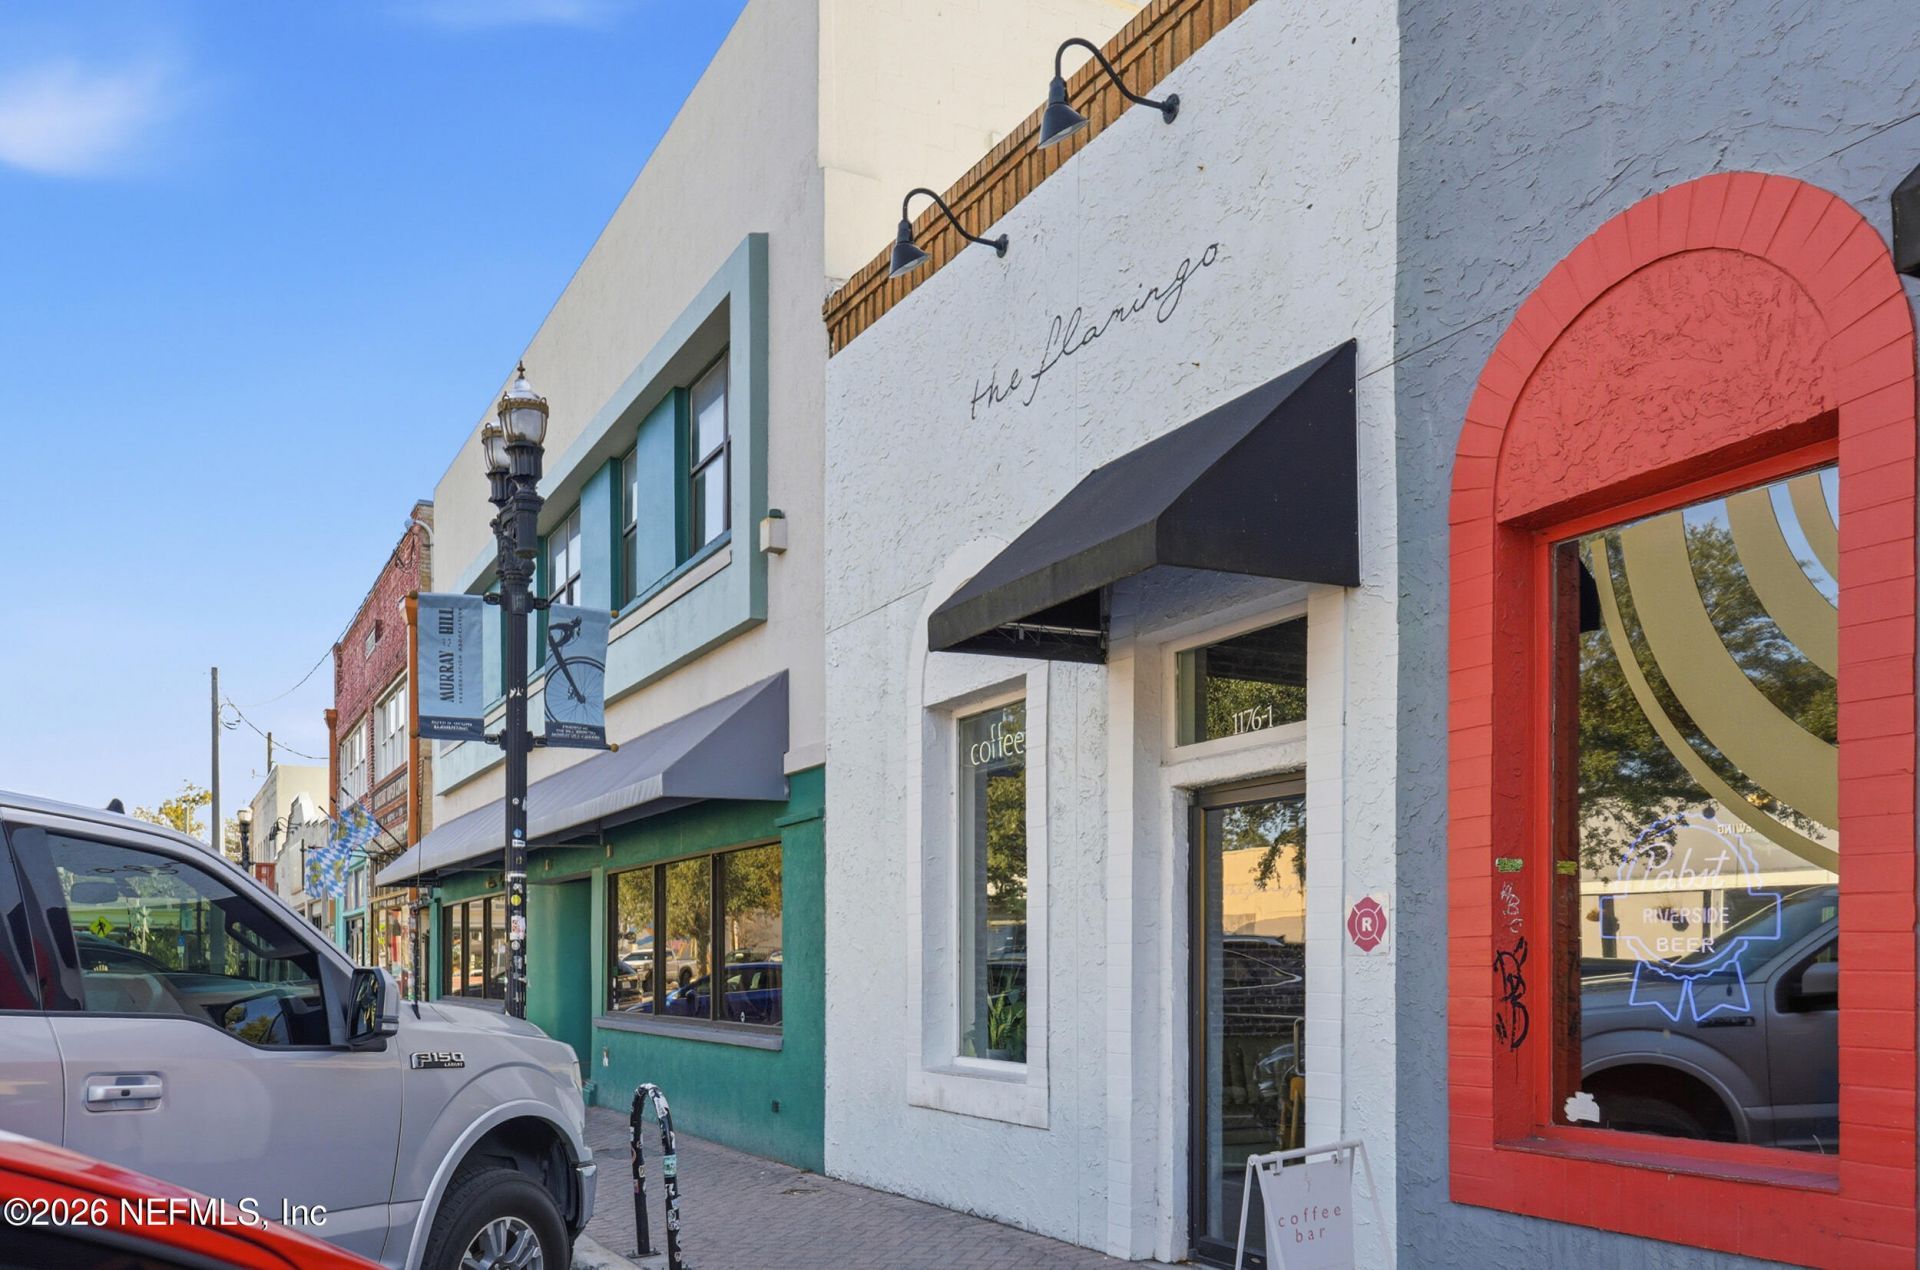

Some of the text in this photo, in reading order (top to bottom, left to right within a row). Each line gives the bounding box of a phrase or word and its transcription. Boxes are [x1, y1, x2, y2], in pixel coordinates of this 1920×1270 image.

[971, 243, 1219, 420] the flamingo
[438, 607, 454, 703] MURRAY HILL
[1232, 704, 1273, 735] 1176-1
[971, 721, 1025, 765] coffee
[1638, 842, 1730, 890] Pabst
[1362, 917, 1373, 932] R
[1642, 907, 1730, 924] RIVERSIDE
[1656, 936, 1716, 954] BEER
[1278, 1206, 1341, 1228] coffee
[1296, 1227, 1325, 1244] bar
